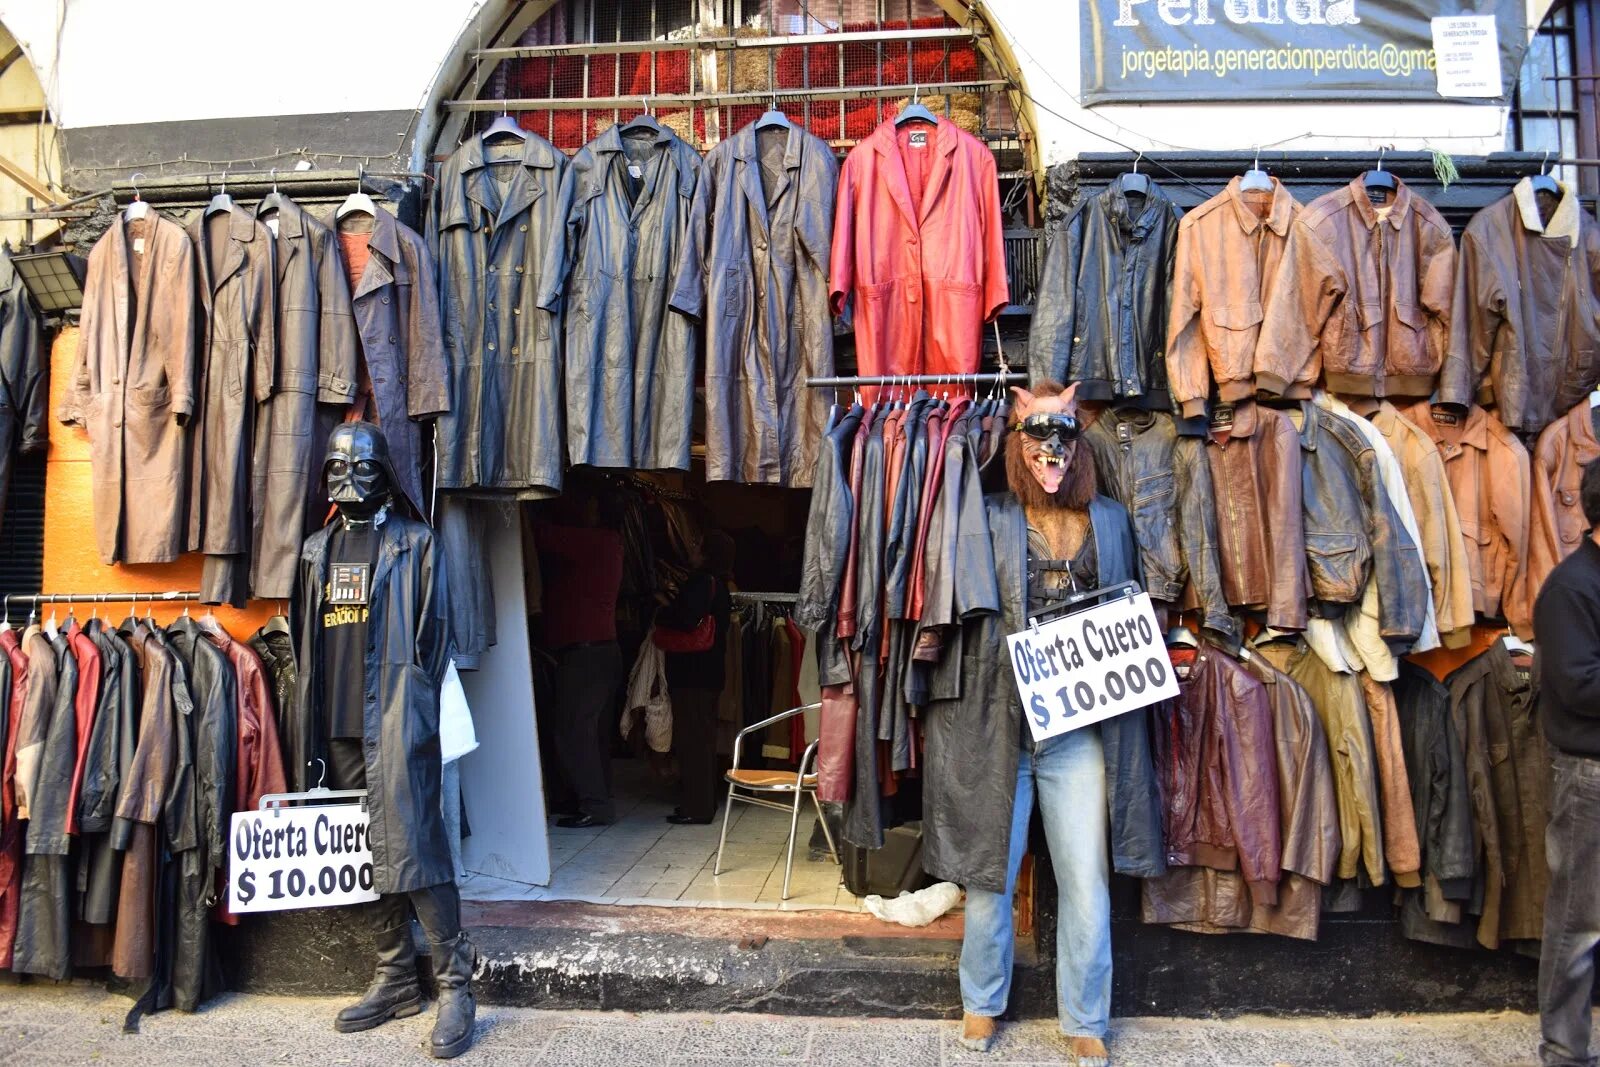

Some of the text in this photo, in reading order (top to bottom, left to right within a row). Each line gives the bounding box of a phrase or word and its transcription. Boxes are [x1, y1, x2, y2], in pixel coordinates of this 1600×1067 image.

[1014, 614, 1153, 685] Oferta Cuero
[1030, 657, 1166, 730] $ 10.000
[235, 817, 307, 861] Oferta
[237, 862, 374, 906] $ 10.000
